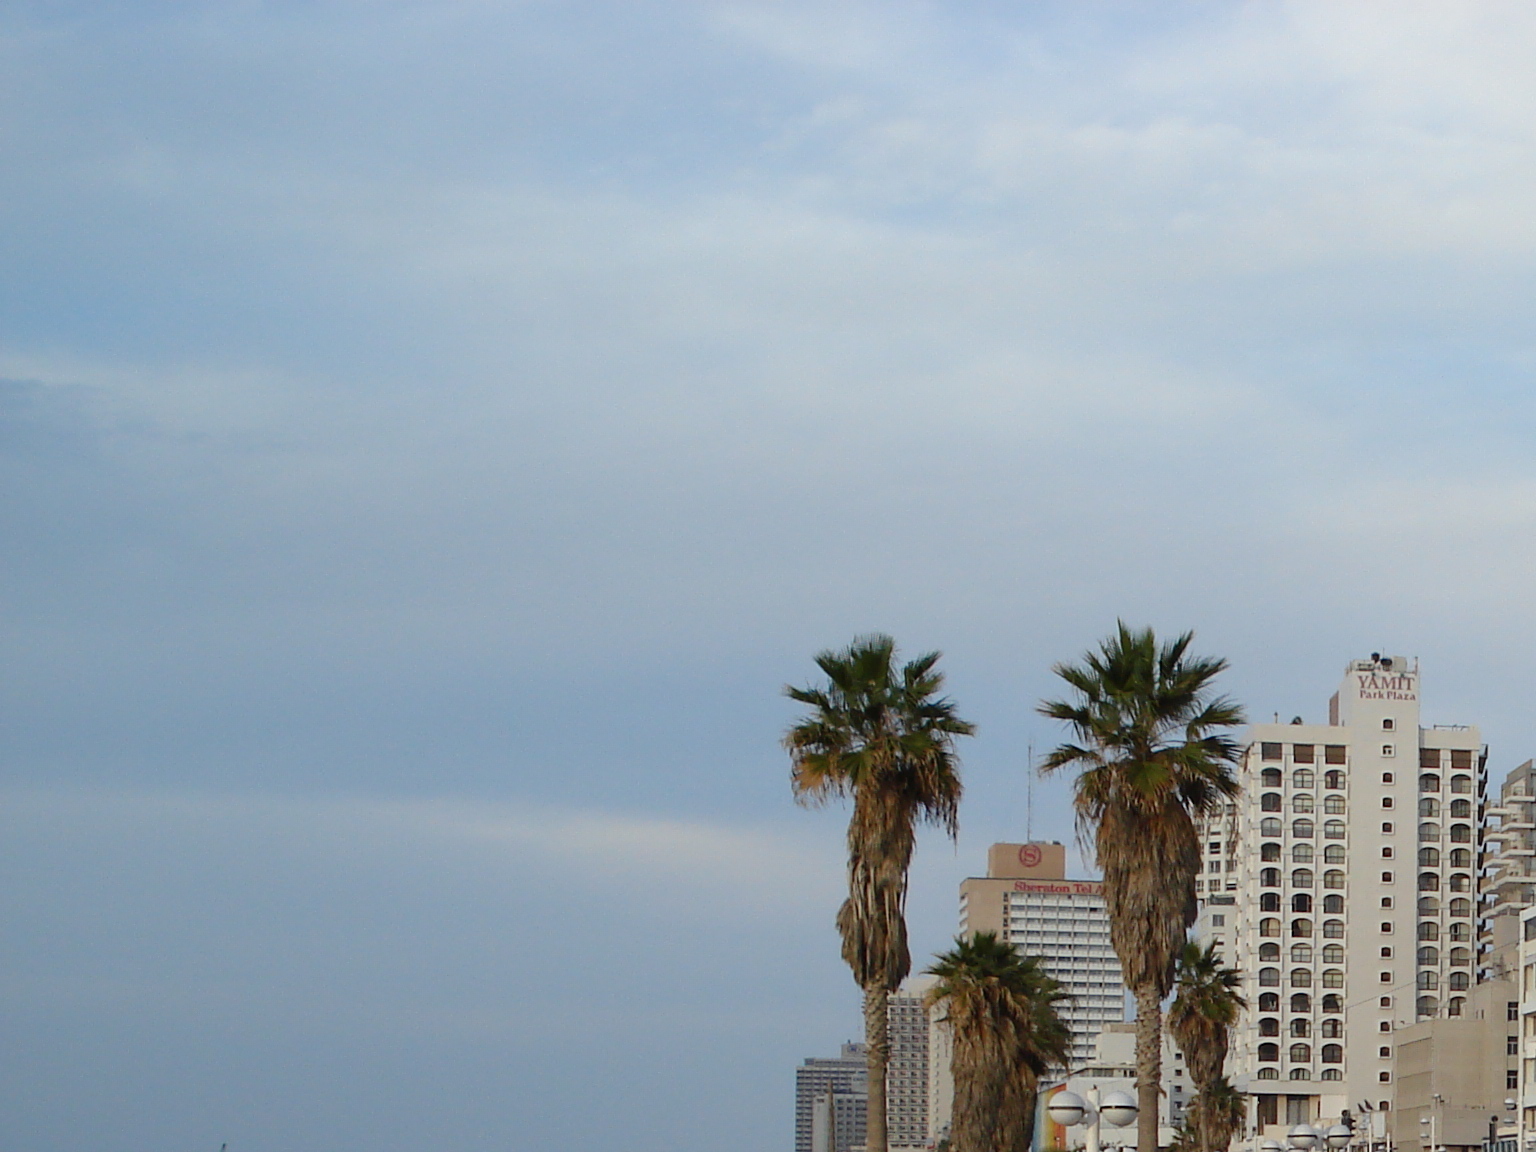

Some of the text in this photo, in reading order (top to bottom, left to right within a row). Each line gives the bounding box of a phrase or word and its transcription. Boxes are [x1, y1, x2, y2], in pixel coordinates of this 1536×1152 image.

[1357, 675, 1415, 690] YAMIT
[1360, 690, 1416, 701] Park Plaza
[1014, 881, 1070, 893] Sheraton
[1073, 883, 1092, 893] Tel
